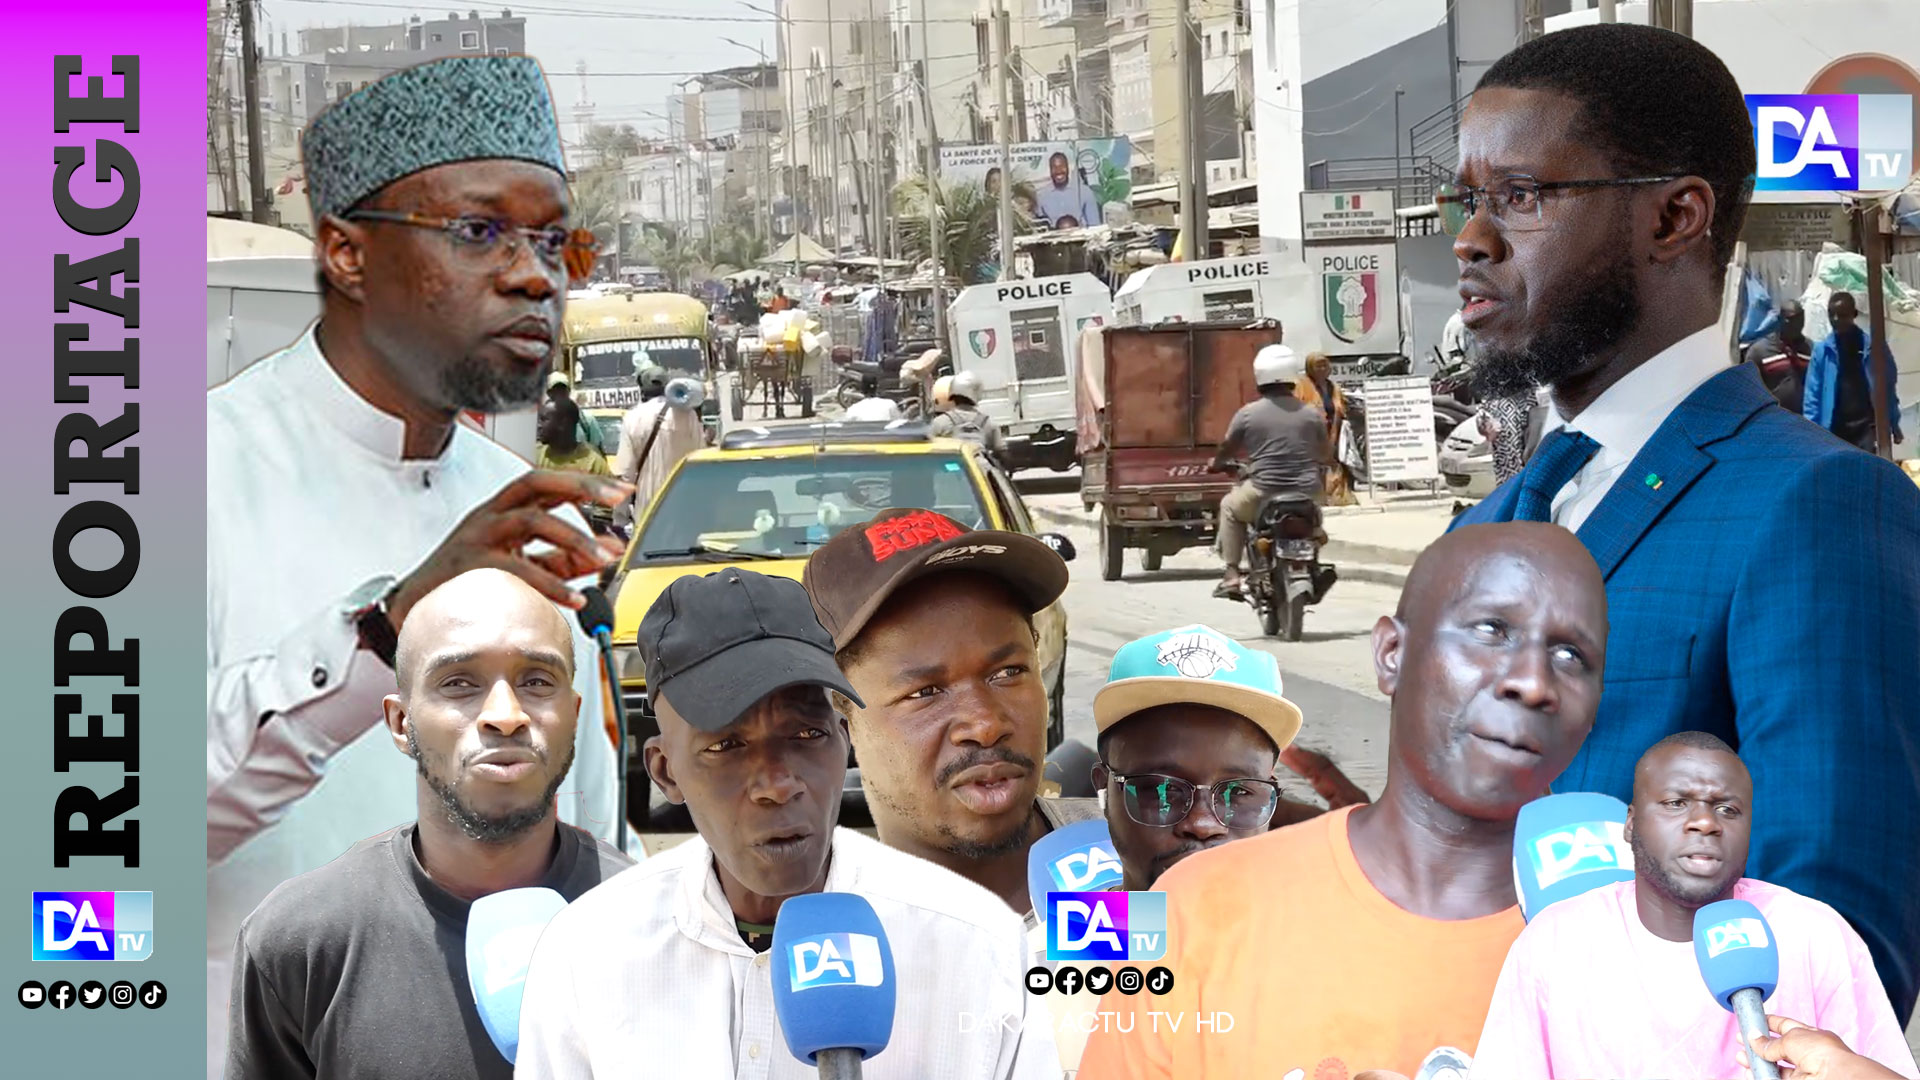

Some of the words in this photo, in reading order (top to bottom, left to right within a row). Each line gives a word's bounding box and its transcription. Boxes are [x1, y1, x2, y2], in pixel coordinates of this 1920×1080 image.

[1188, 262, 1269, 282] POLICE
[1323, 255, 1379, 271] POLICE
[997, 281, 1072, 301] POLICE
[792, 938, 852, 979] DA
